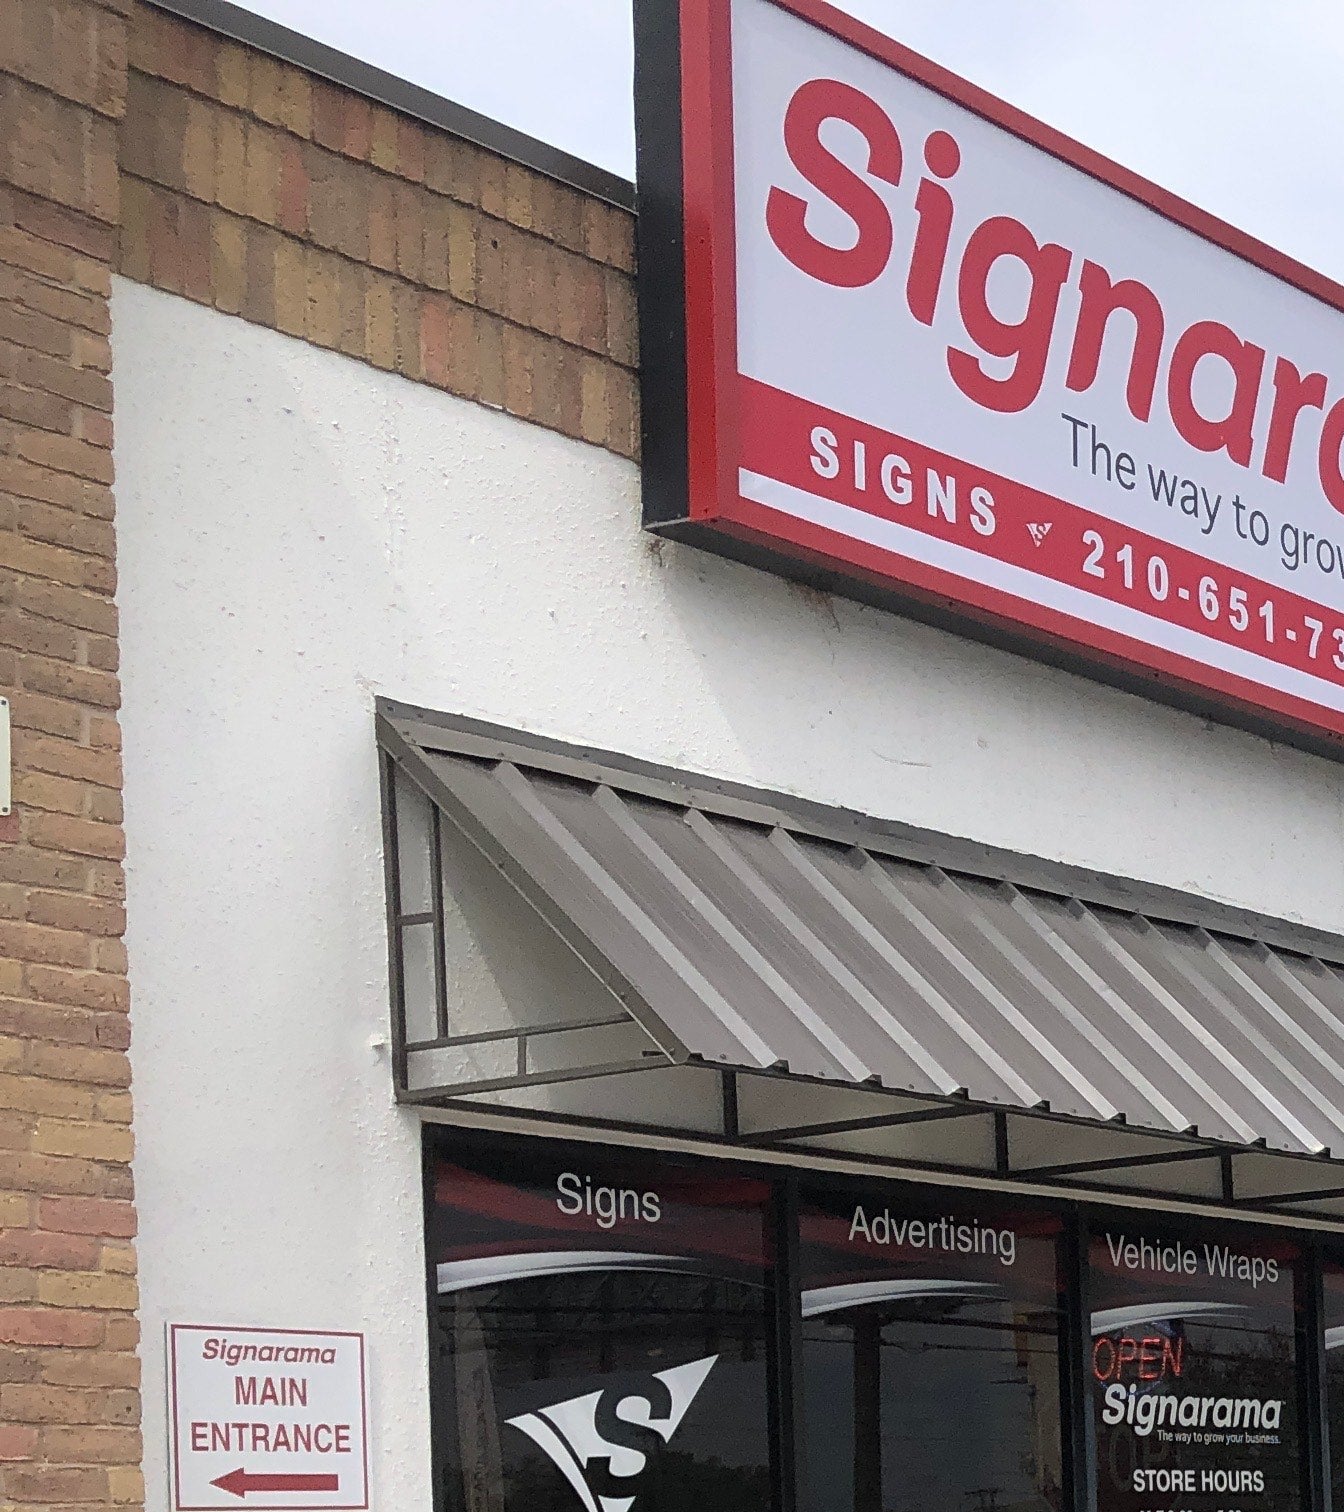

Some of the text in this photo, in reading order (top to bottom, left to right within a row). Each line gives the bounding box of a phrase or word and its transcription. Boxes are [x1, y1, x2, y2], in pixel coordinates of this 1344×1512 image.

[809, 424, 996, 538] SIGNS
[1061, 412, 1137, 492] The
[1147, 468, 1220, 536] way
[1231, 493, 1270, 547] to
[556, 1172, 661, 1228] Signs
[848, 1205, 1016, 1266] Advertising
[1106, 1232, 1279, 1289] Vehicle Wraps
[202, 1338, 336, 1366] Signarama
[1093, 1336, 1182, 1381] OPEN
[234, 1376, 308, 1407] MAIN
[1102, 1383, 1281, 1437] Signarama
[190, 1422, 351, 1453] ENTRANCE
[1157, 1429, 1281, 1446] The way to grow your business.
[1133, 1470, 1265, 1492] STORE HOURS
